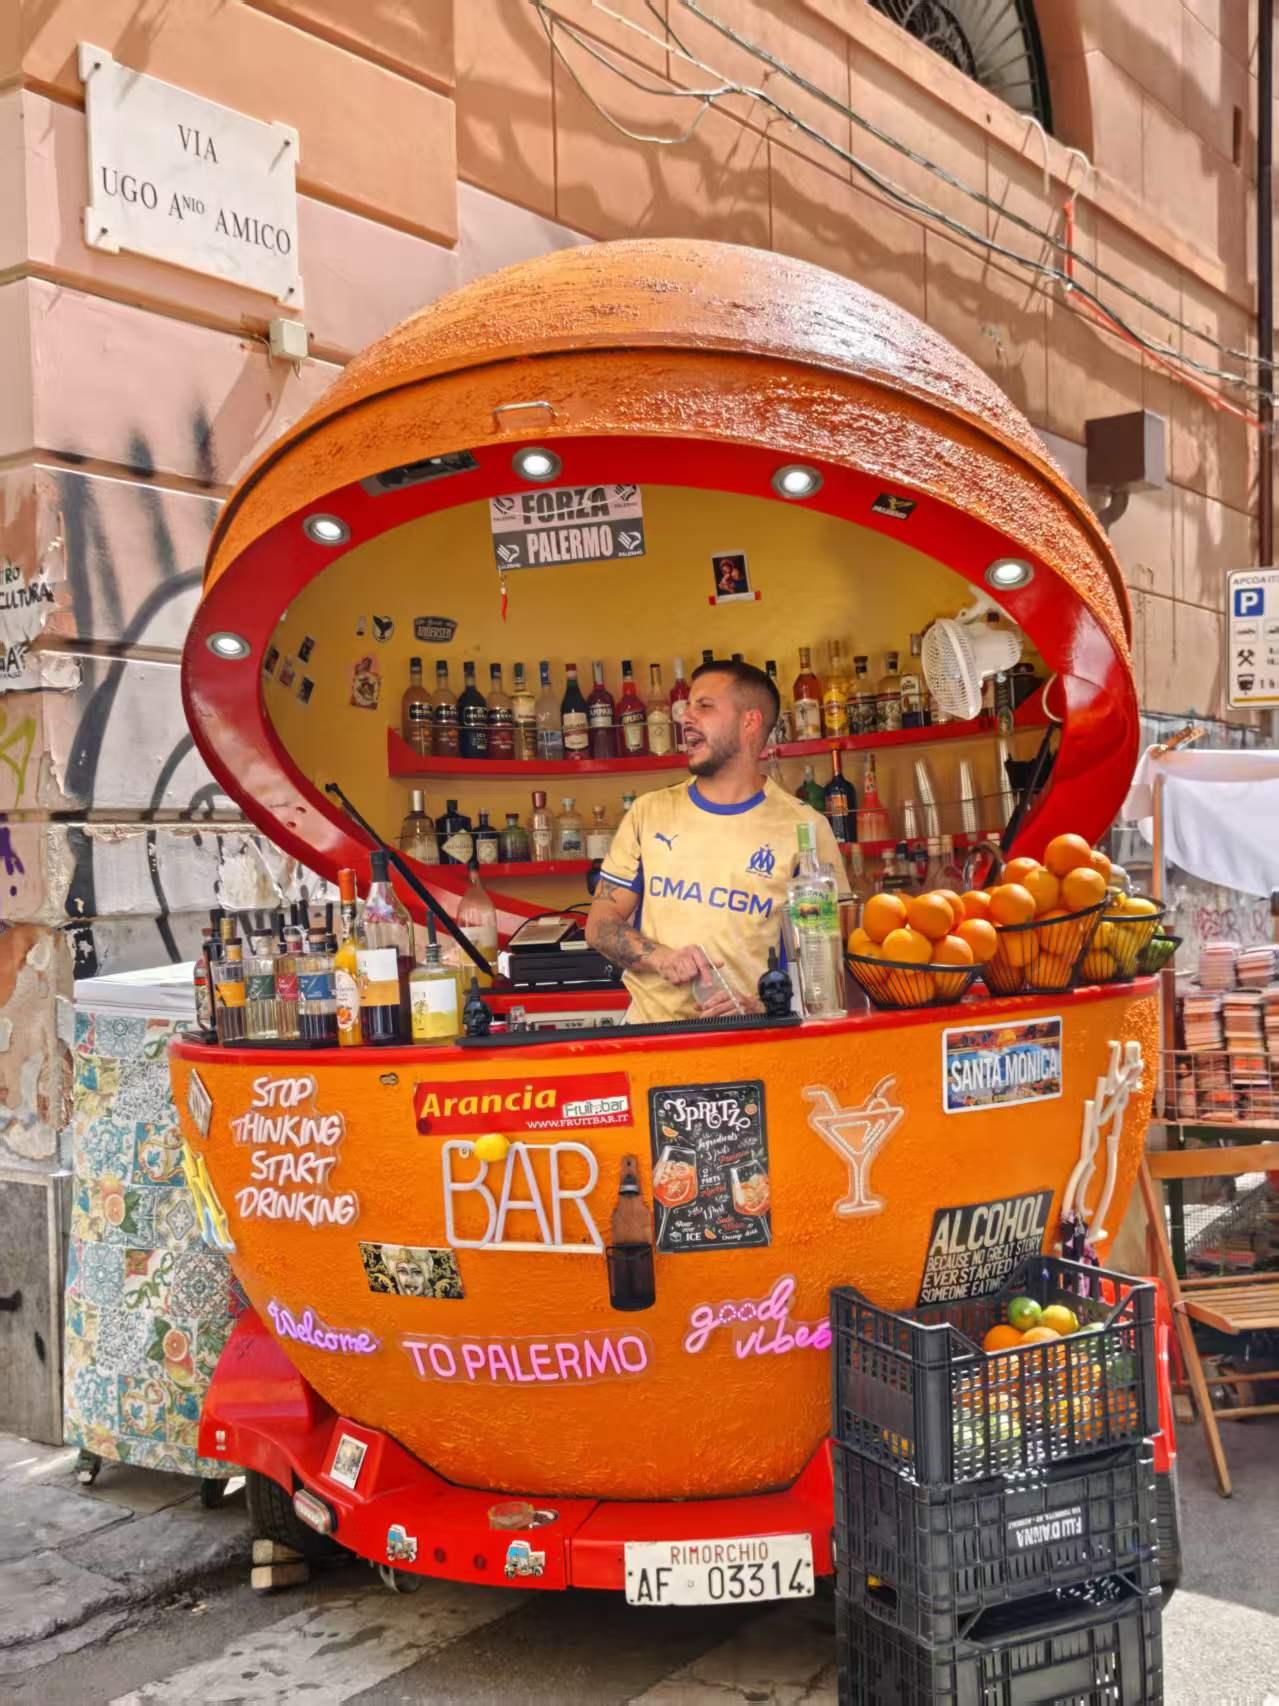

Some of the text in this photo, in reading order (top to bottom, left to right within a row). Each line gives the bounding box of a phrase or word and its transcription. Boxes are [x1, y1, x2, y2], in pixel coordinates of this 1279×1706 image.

[177, 124, 218, 164] VIA
[101, 166, 158, 210] UGO
[214, 208, 292, 255] AMICO
[521, 486, 610, 525] FORZA
[526, 525, 614, 565] PALERMO
[1240, 591, 1258, 614] P
[649, 875, 774, 918] CMA CGM
[951, 1048, 1058, 1092] SANTA MONICA
[251, 1077, 313, 1107] STOP
[420, 1085, 557, 1118] Arancia
[231, 1112, 342, 1147] THINKING
[251, 1150, 336, 1186] START
[234, 1186, 355, 1227] DRINKING
[441, 1139, 604, 1253] BAR
[686, 1231, 702, 1241] ICE
[929, 1193, 1045, 1257] ALCOHOL
[922, 1268, 960, 1289] EVER
[960, 1257, 1014, 1283] STARTED
[926, 1250, 972, 1273] BECAUSE
[971, 1248, 987, 1265] NO
[986, 1242, 1015, 1262] GREAT
[1015, 1235, 1042, 1257] STORY
[921, 1276, 1007, 1304] SOMEONE EATIN
[266, 1300, 377, 1353] Welcome
[685, 1277, 796, 1354] good
[736, 1317, 833, 1359] vibes
[402, 1335, 648, 1382] TO PALERMO
[670, 1541, 769, 1565] RIMORCHIO
[637, 1558, 805, 1602] AF 03314
